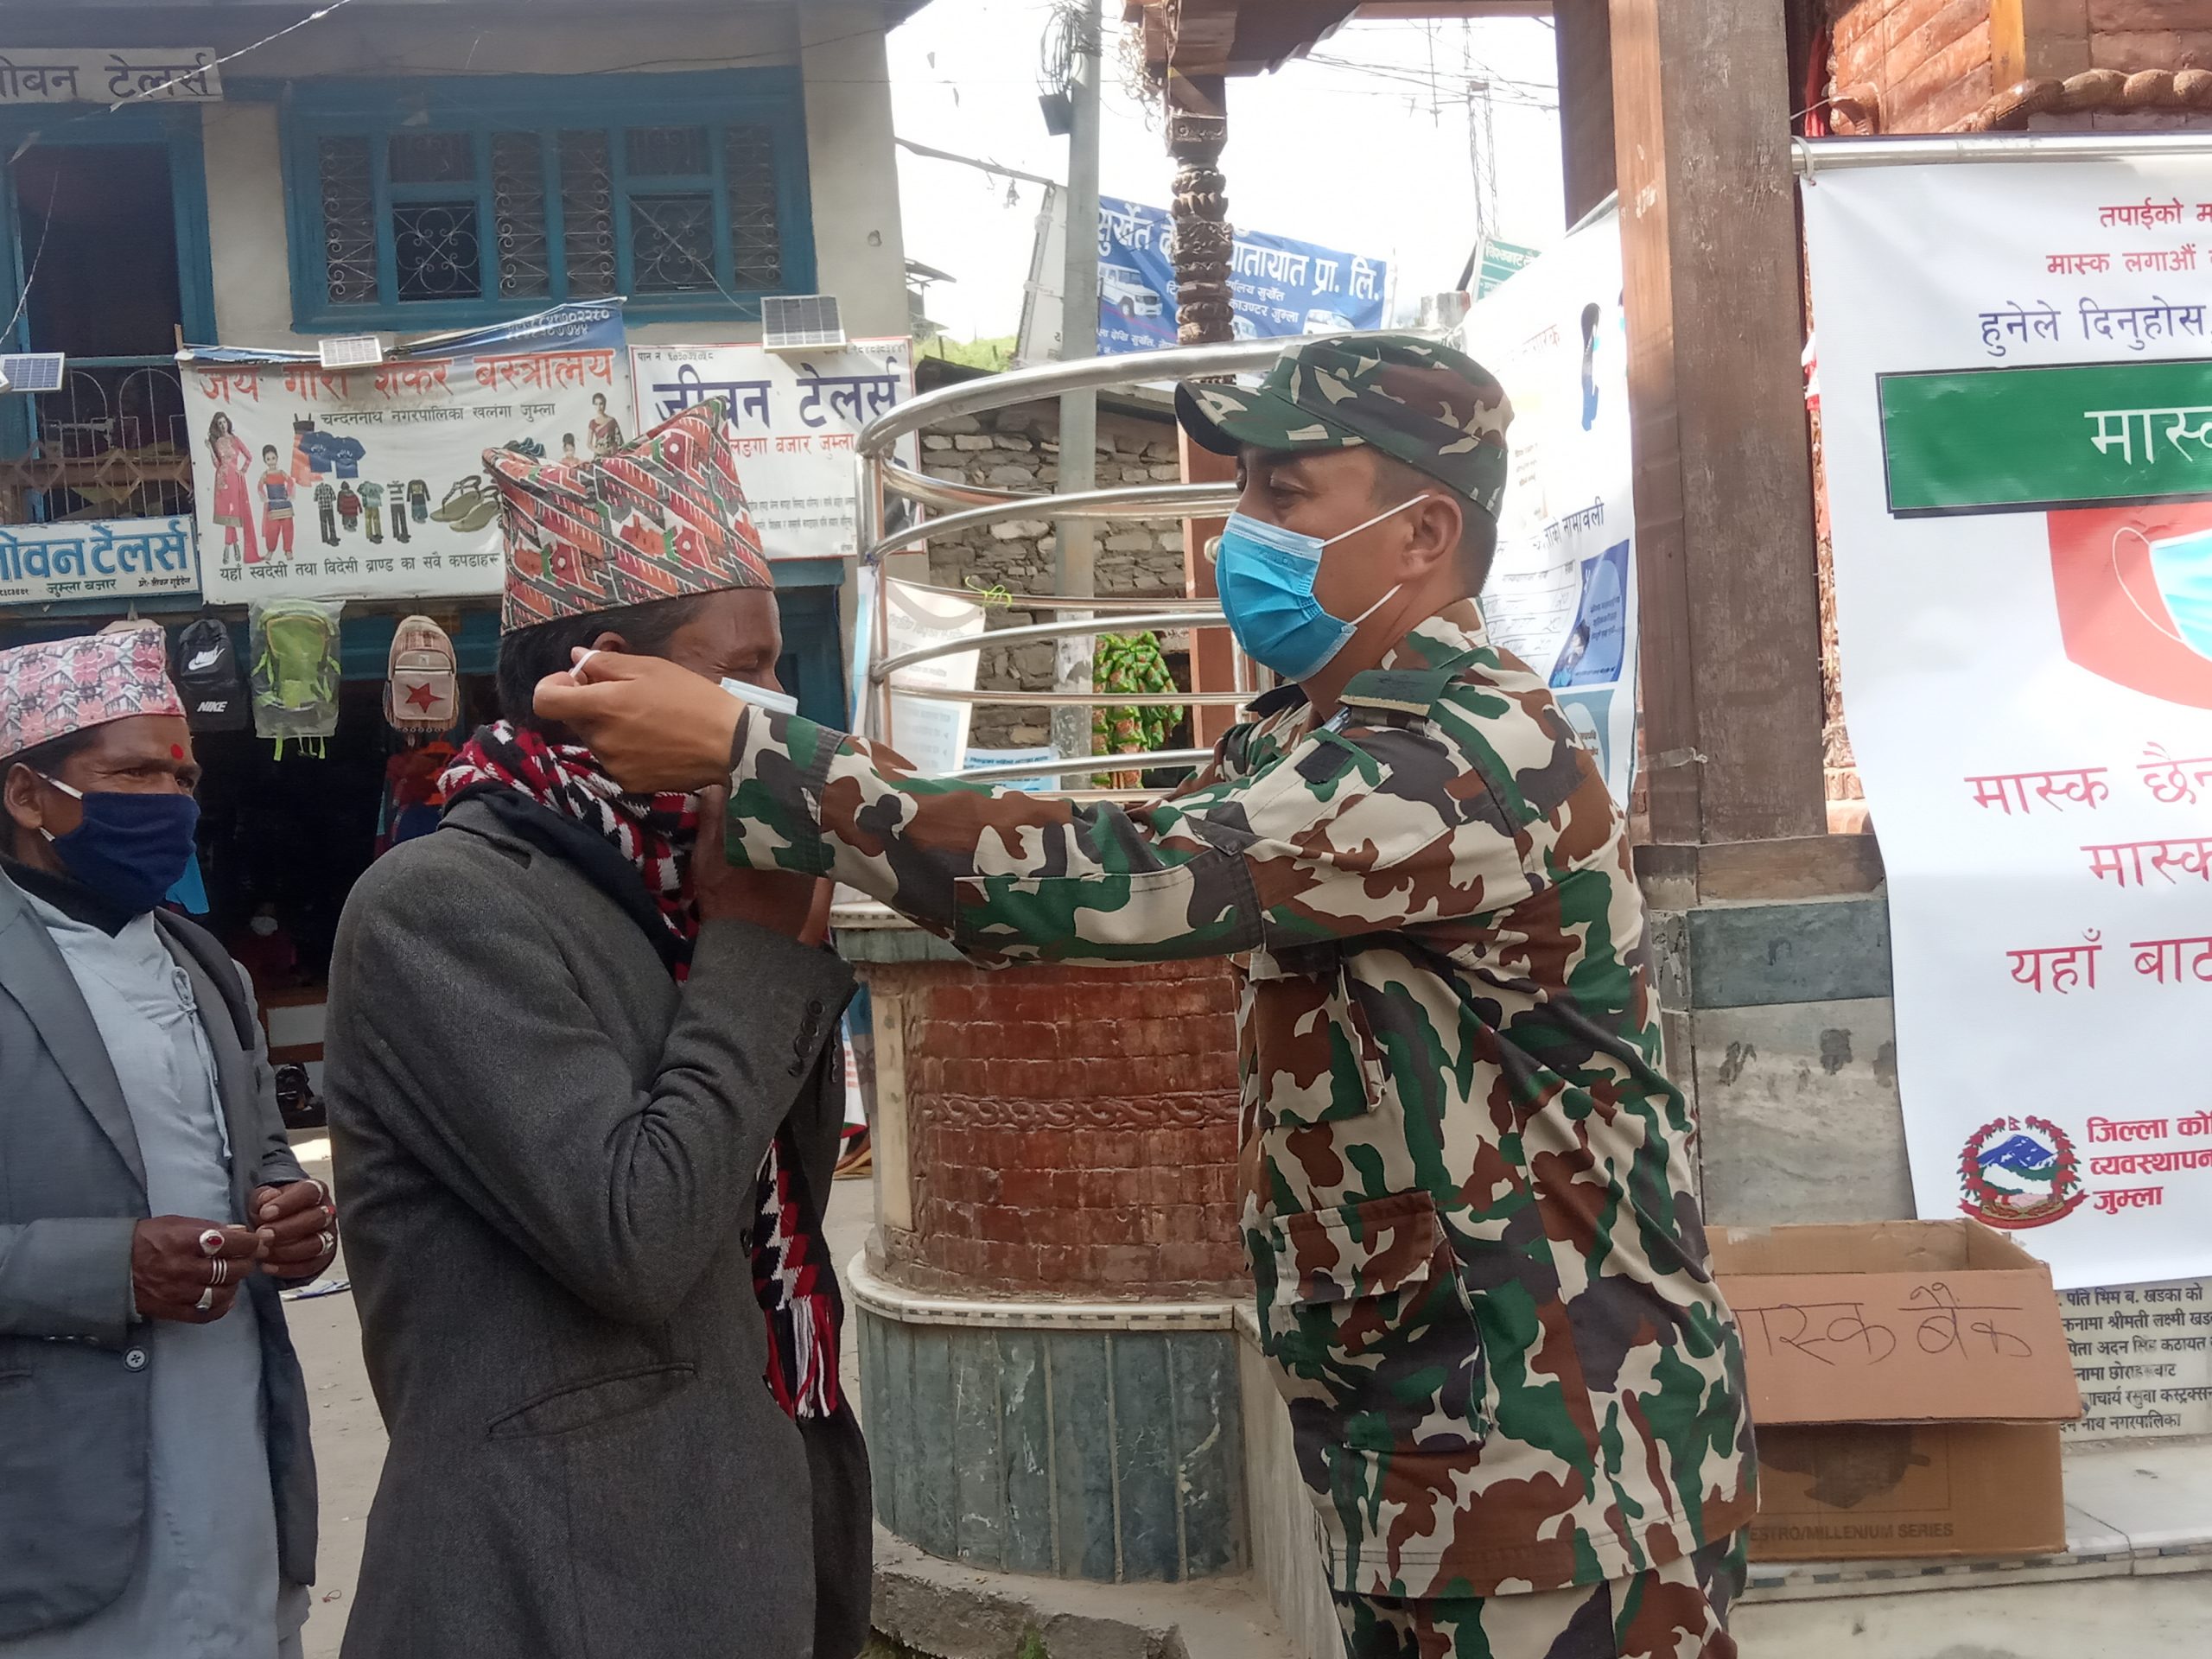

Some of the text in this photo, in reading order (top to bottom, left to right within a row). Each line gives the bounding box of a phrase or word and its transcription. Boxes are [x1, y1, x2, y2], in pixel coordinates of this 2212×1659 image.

[2045, 252, 2110, 275] मास्क
[1312, 258, 1339, 296] प्रा.
[1348, 255, 1380, 302] लि.
[1978, 300, 2061, 357] हुनेले
[197, 365, 259, 404] जय
[797, 356, 900, 428] टेलर्स
[321, 403, 556, 426] चन्दननाथ नगरपालिका खलंगा जुम्ला
[729, 438, 767, 458] लङगा
[89, 518, 188, 576] टेलर्स
[219, 563, 242, 582] यहाँ
[296, 563, 317, 576] तथा
[324, 556, 359, 575] विदेसी
[401, 556, 415, 570] का
[46, 581, 81, 598] जुम्ला
[196, 701, 228, 713] NIKE
[1963, 767, 2108, 816] मास्क
[2080, 837, 2212, 888] मास्क
[2006, 928, 2212, 995] यहाँ बाट
[2087, 1116, 2169, 1143] जिल्ला
[2093, 1186, 2164, 1215] जुम्ला
[2067, 1287, 2091, 1306] पति
[2144, 1288, 2182, 1303] खडका
[2185, 1282, 2202, 1301] को
[2107, 1310, 2150, 1329] श्रीमती
[2152, 1307, 2186, 1327] लक्ष्मी
[2189, 1312, 2212, 1325] खड
[1731, 1302, 1897, 1366] ास्क
[2161, 1337, 2207, 1351] कठायत
[2073, 1367, 2105, 1381] नामा
[2109, 1409, 2181, 1430] नगरपालिका
[1897, 1523, 1954, 1538] SERIES
